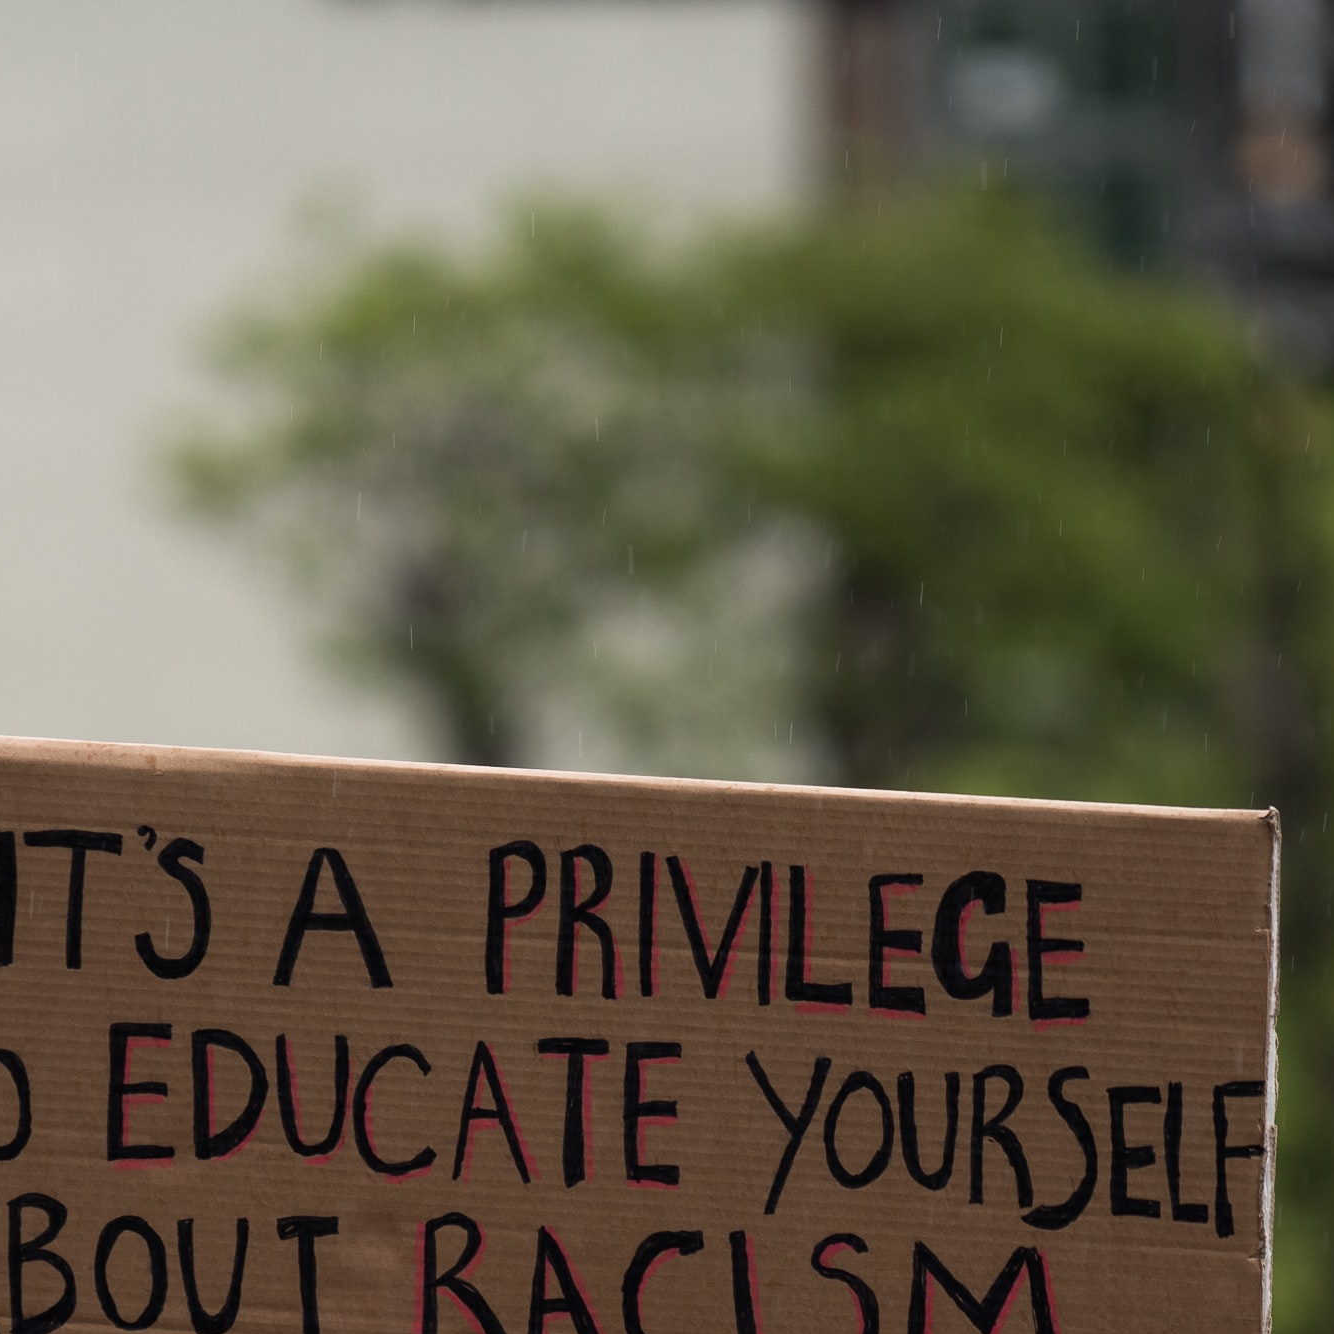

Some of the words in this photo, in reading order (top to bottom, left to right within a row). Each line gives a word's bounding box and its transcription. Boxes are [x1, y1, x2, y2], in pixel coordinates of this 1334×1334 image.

[272, 846, 395, 989] A
[484, 839, 1092, 1026] PRIVILEGE
[106, 1021, 683, 1189] EDUCATE
[744, 1049, 1266, 1240] YOURSELF
